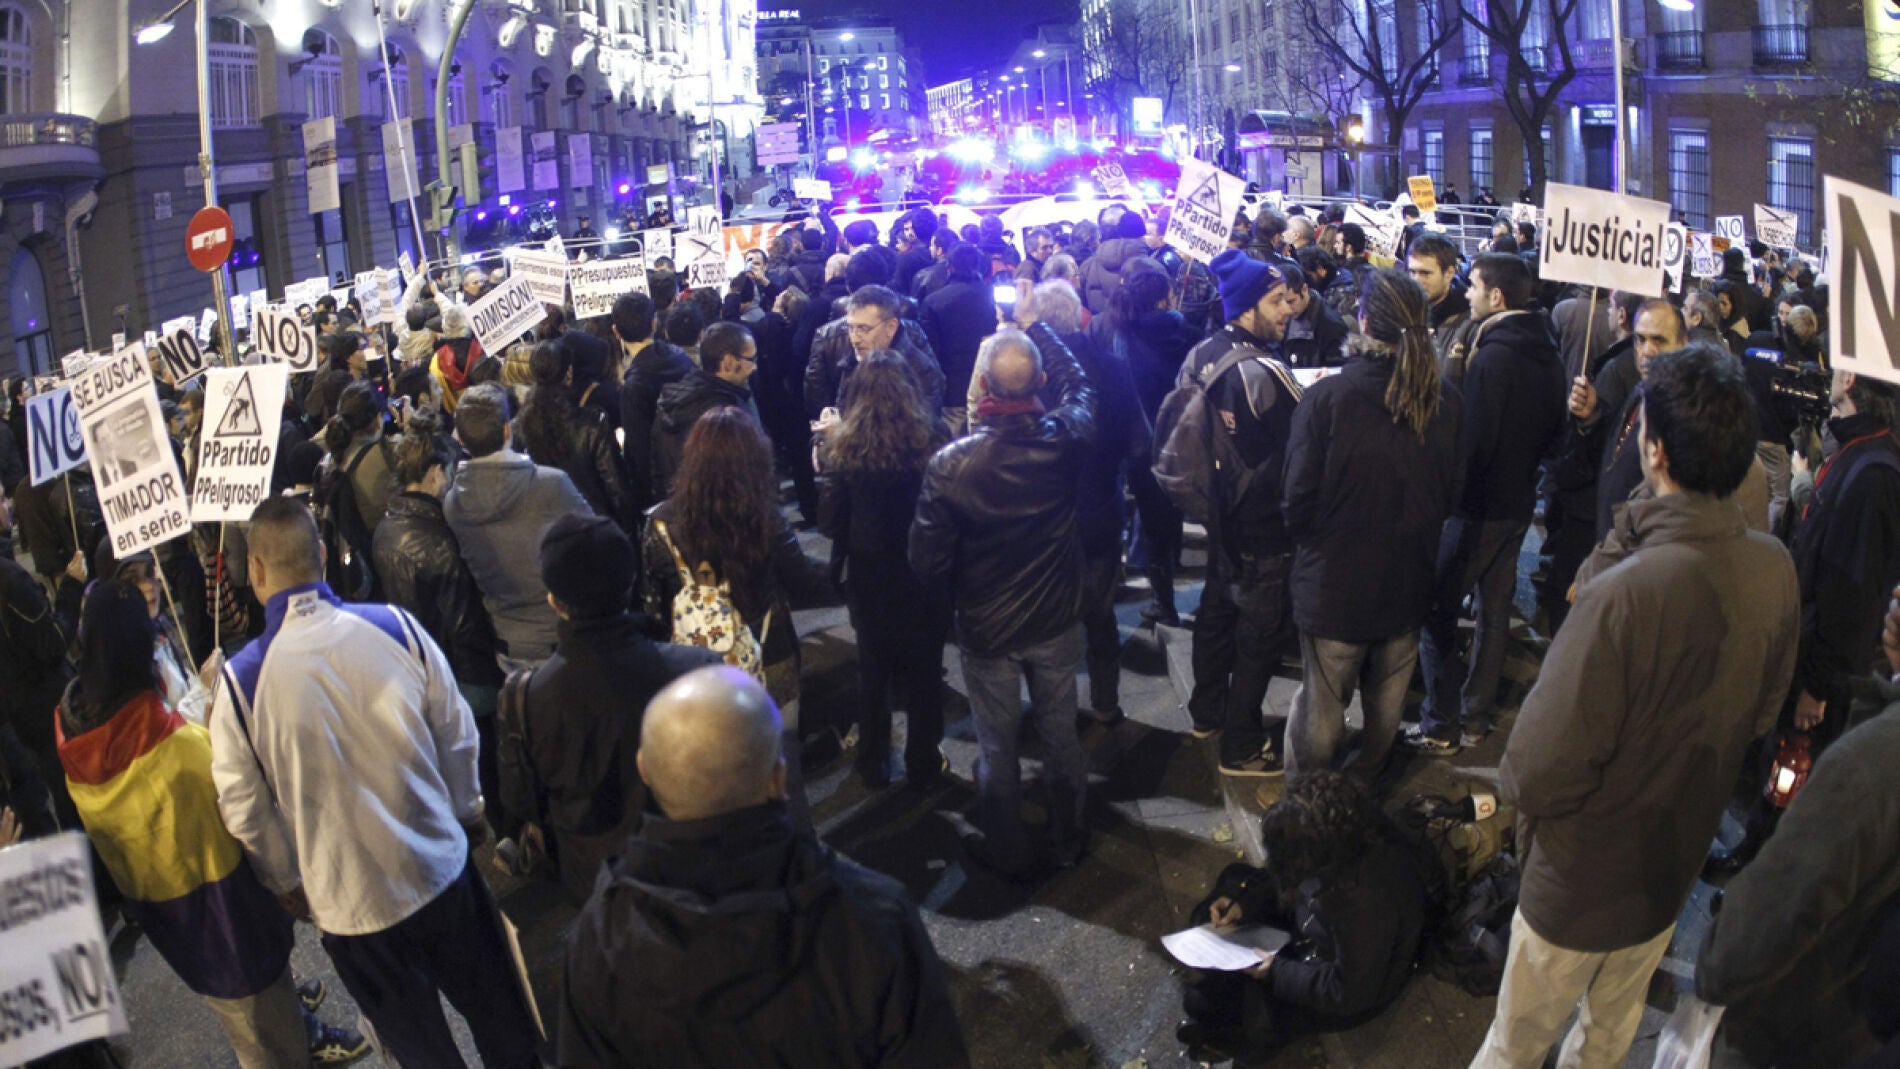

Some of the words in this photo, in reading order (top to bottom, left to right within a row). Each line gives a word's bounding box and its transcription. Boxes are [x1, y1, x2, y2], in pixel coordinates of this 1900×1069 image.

[1176, 197, 1228, 238] PPartido
[1544, 206, 1664, 270] ¡Justicia!
[1717, 217, 1744, 238] NO
[570, 261, 644, 287] PPresupuestos
[158, 328, 201, 380] NO
[257, 310, 300, 358] NO
[73, 378, 93, 411] SE
[93, 351, 146, 399] BUSCA
[29, 391, 86, 477] NO
[201, 438, 270, 468] PPartido
[103, 472, 178, 525] TIMADOR
[194, 476, 266, 513] PPeligroso!
[116, 530, 138, 552] en
[138, 508, 189, 543] serie.
